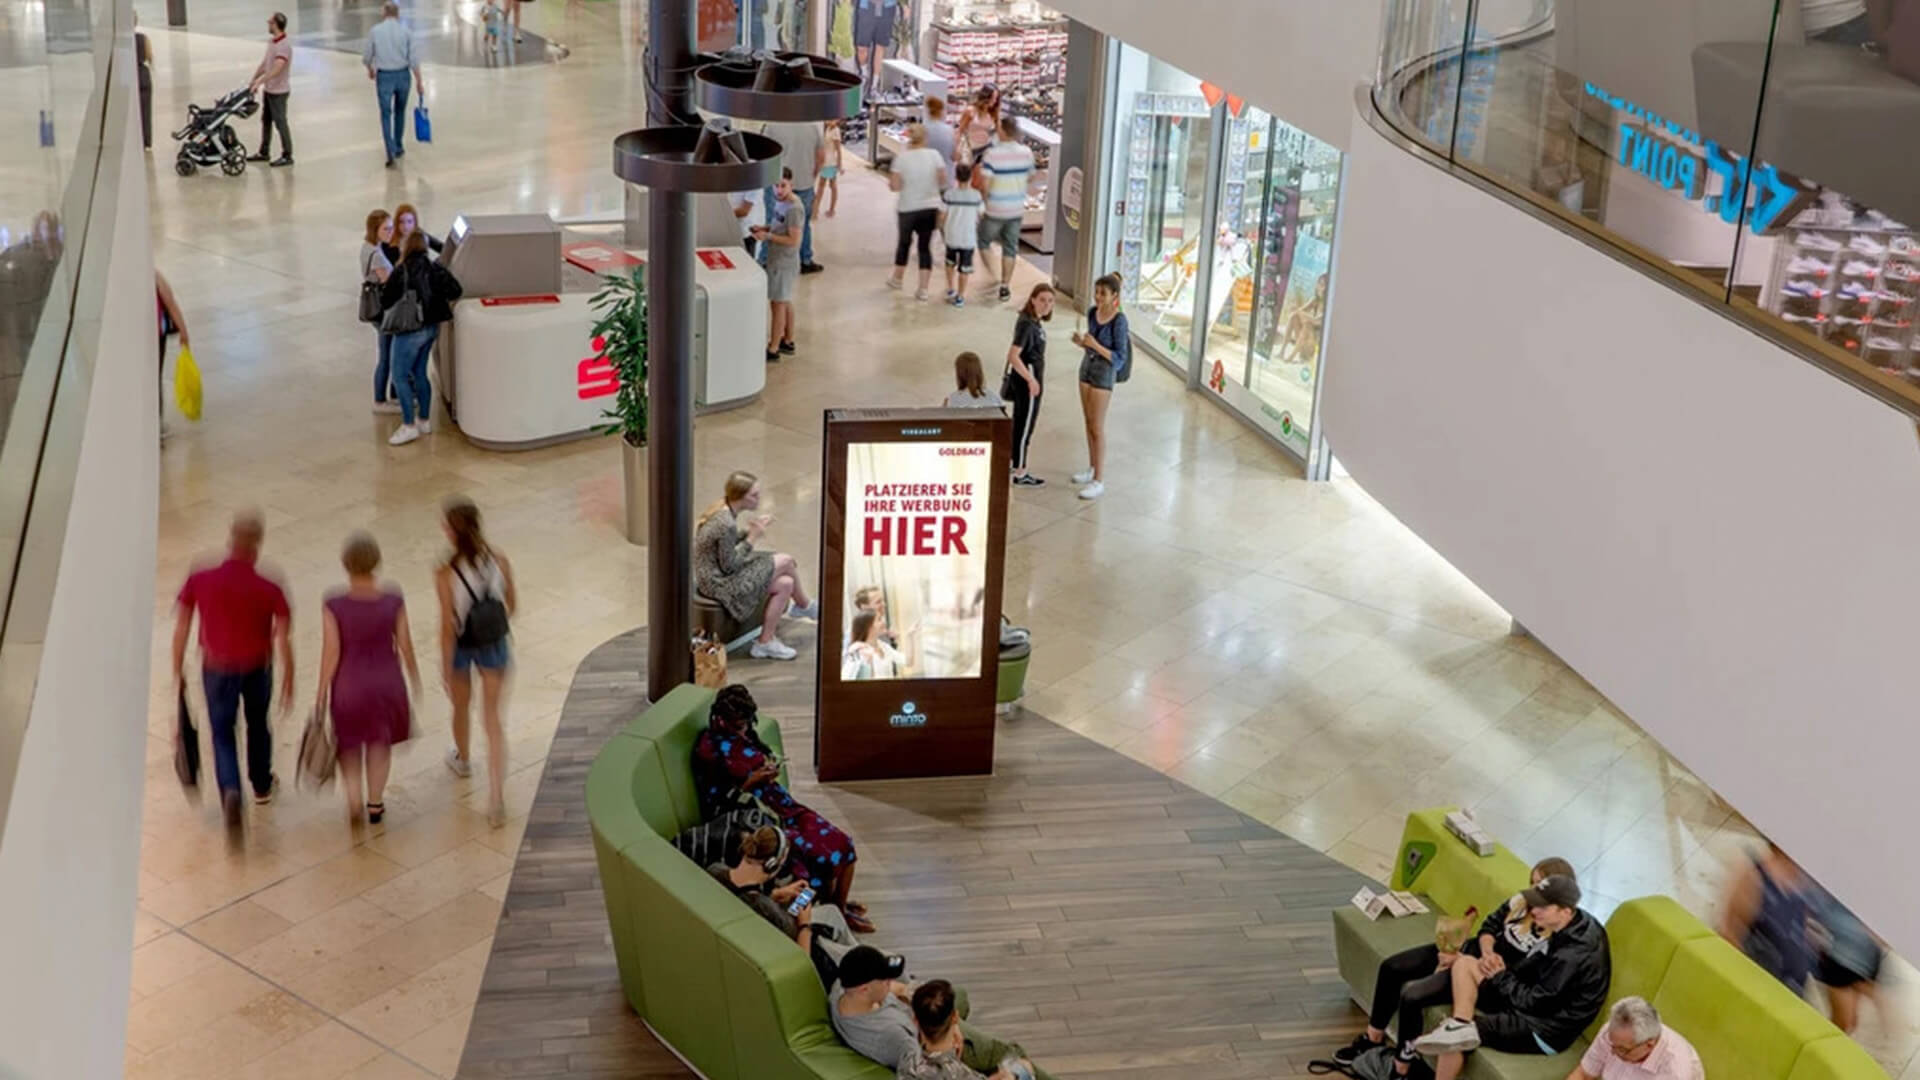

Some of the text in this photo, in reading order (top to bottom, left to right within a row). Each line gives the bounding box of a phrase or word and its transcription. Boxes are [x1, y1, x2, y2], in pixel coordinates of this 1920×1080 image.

[939, 447, 986, 456] GOLDBACH
[865, 483, 973, 496] PLATZIEREN SIE
[864, 499, 972, 512] IHRE WERBUNG
[863, 516, 970, 556] HIER
[889, 710, 927, 724] minto
